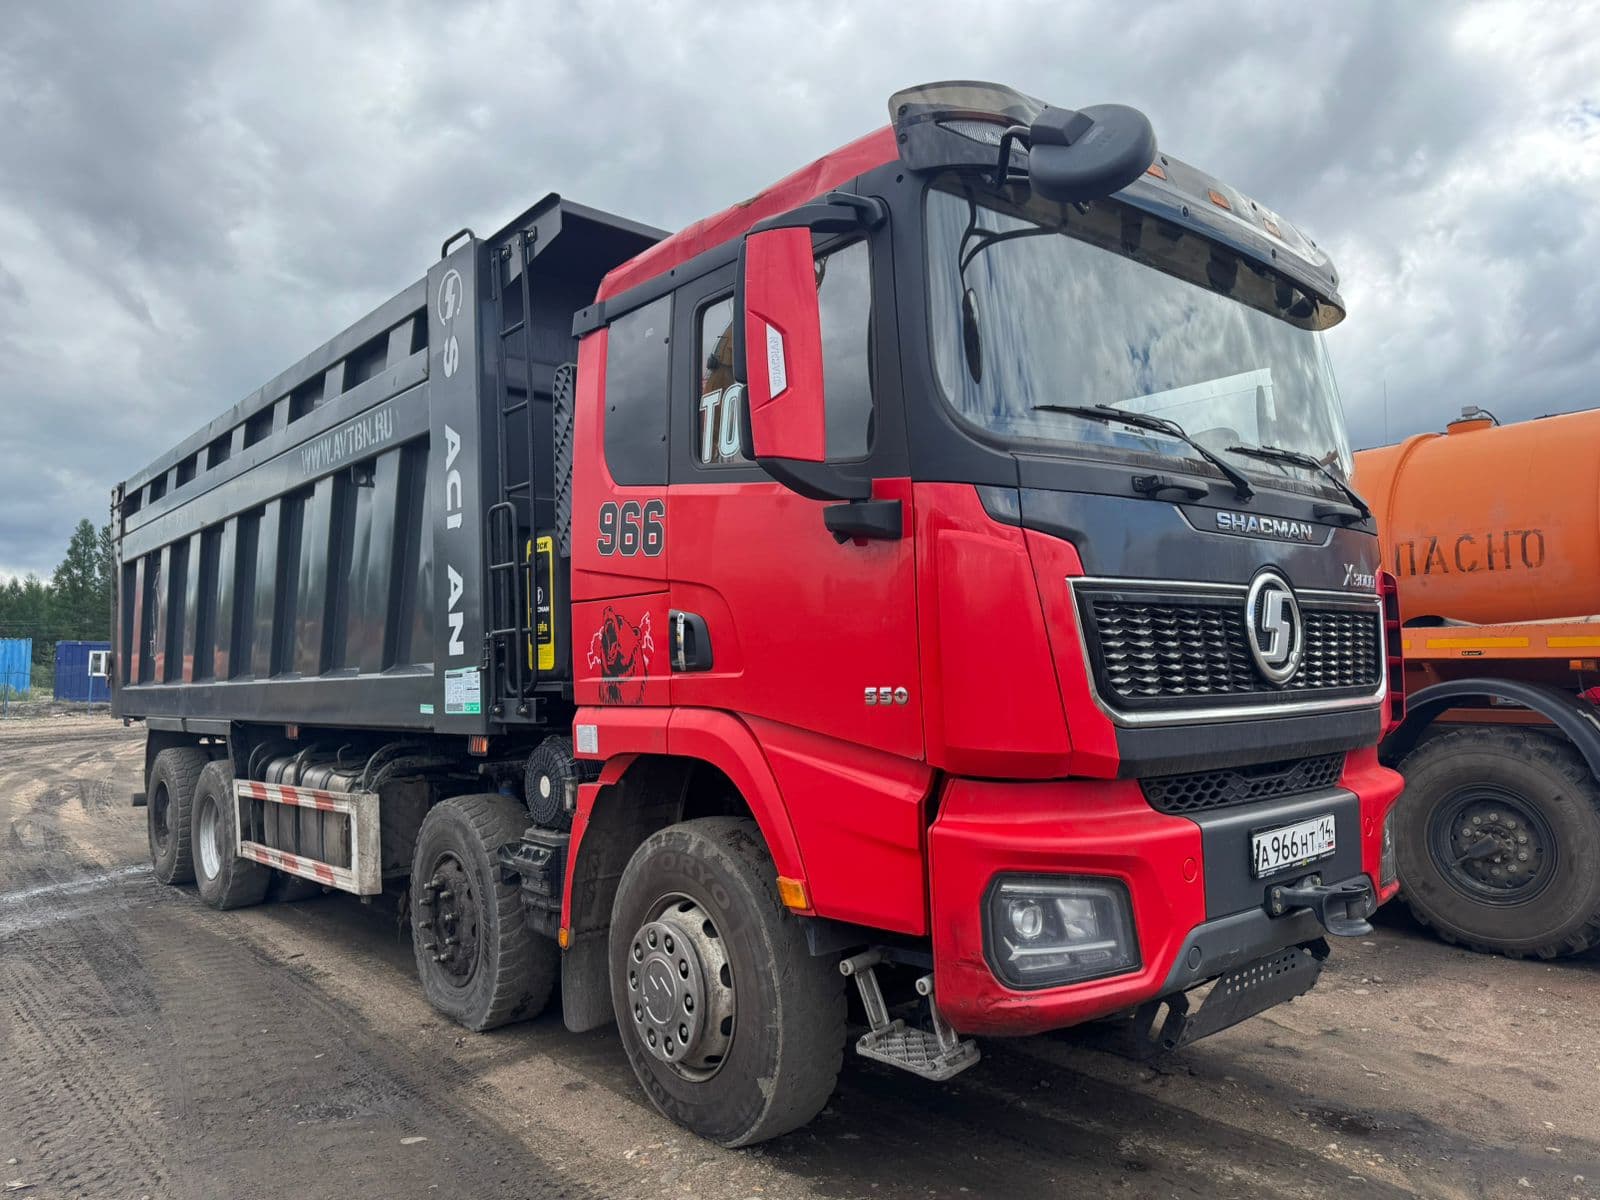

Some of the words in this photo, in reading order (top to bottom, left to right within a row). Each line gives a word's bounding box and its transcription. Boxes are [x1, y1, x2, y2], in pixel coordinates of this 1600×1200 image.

[597, 499, 665, 557] 966
[1216, 511, 1313, 542] SHACMAN
[1394, 528, 1545, 577] ПАСНО
[864, 686, 908, 706] 550
